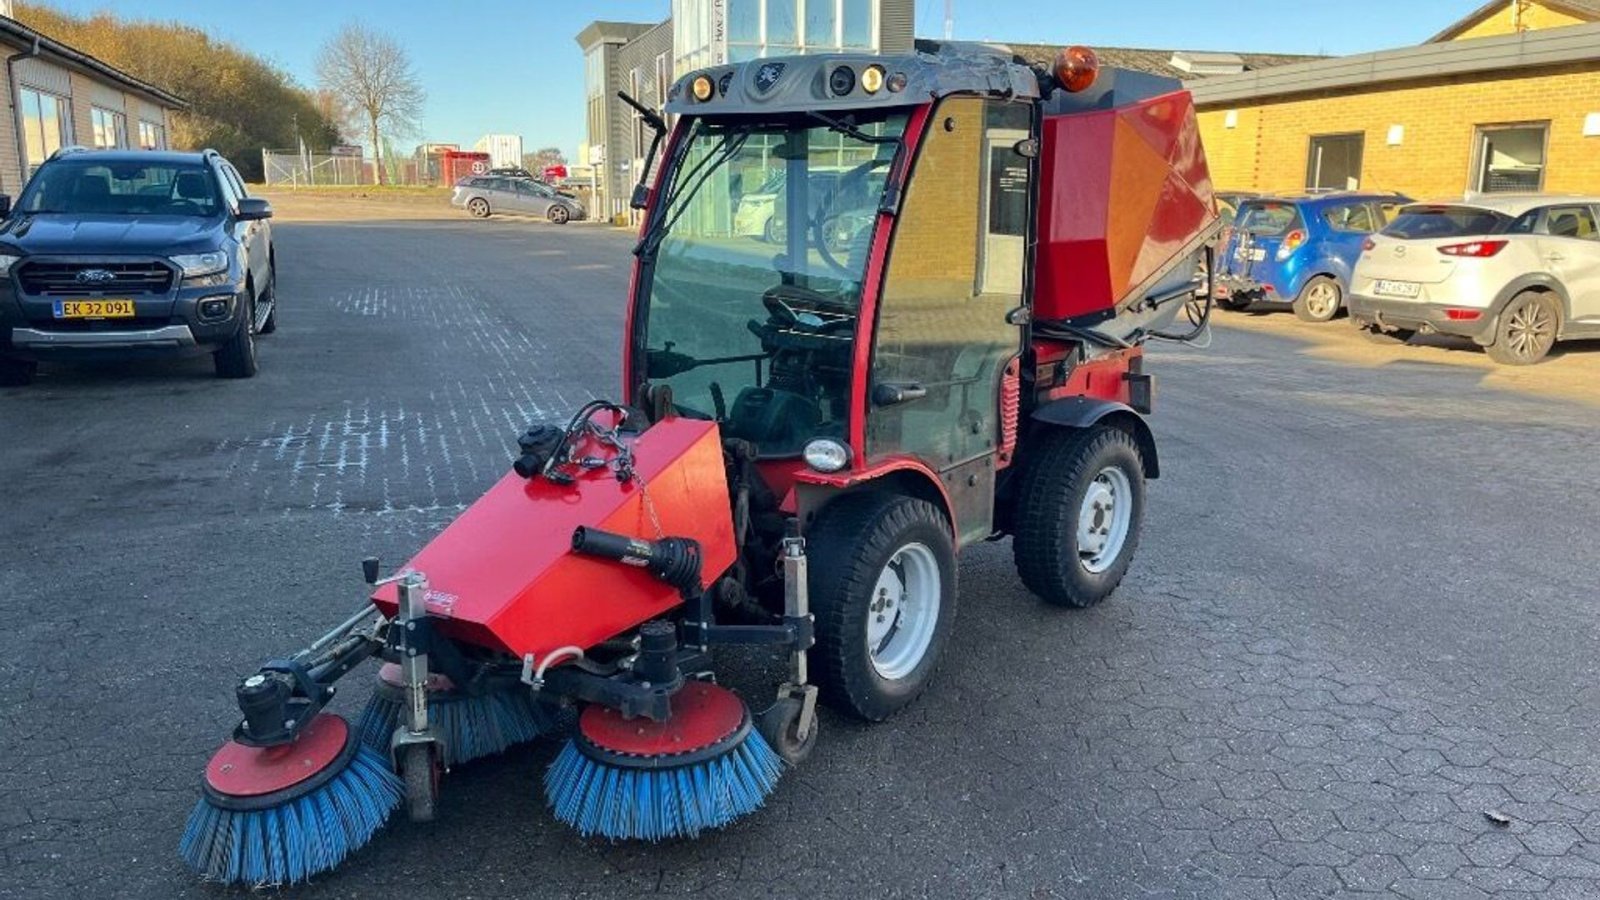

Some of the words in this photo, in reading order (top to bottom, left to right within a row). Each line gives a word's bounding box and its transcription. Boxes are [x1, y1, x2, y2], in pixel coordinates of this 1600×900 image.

[64, 303, 80, 315] EK
[86, 303, 102, 315] 32
[106, 302, 130, 314] 091
